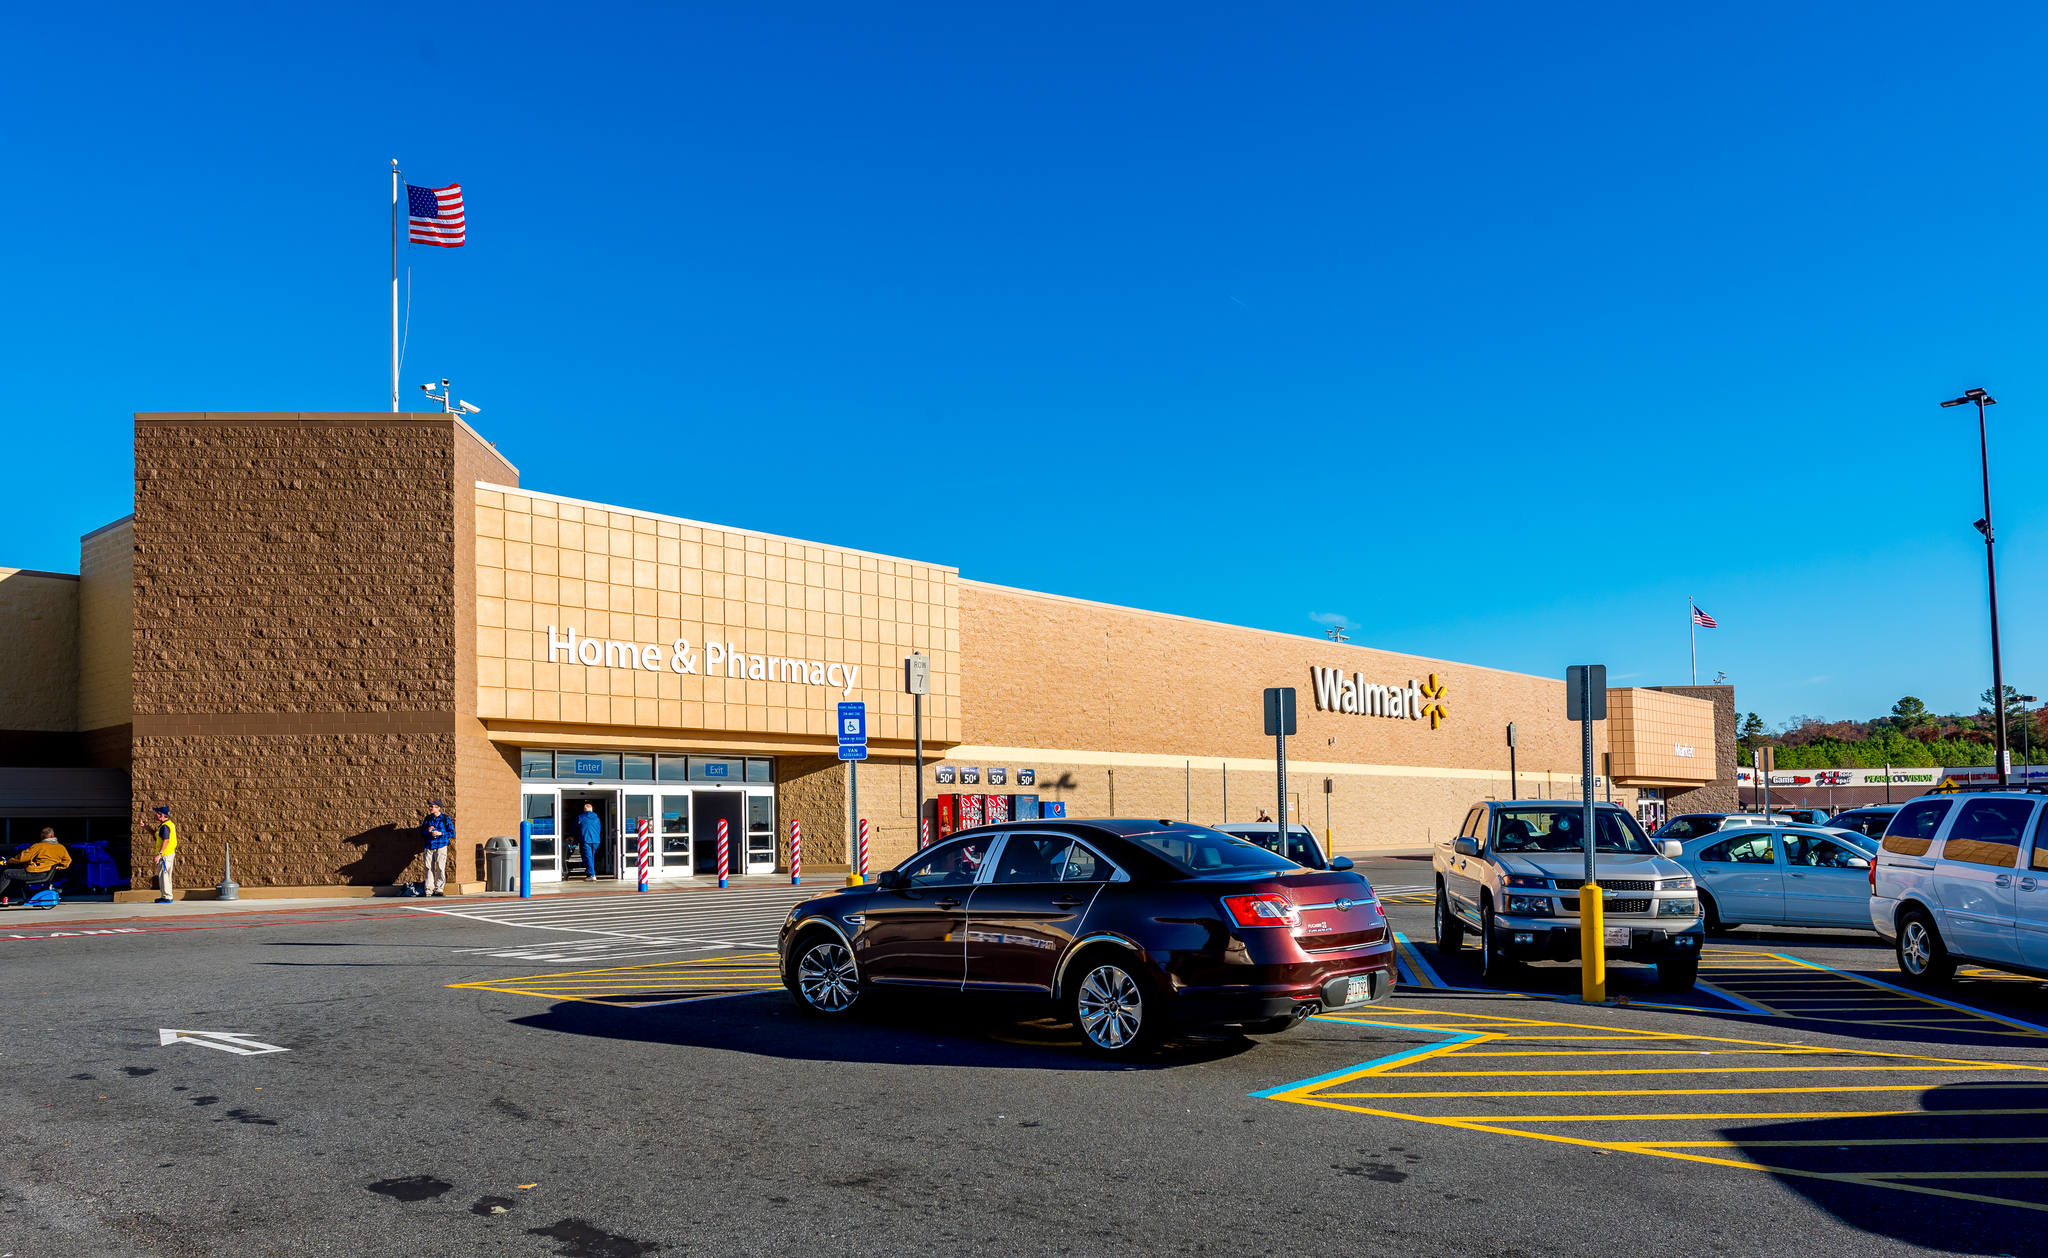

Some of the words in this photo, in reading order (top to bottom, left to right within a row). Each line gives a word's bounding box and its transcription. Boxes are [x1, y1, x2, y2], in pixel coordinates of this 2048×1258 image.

[548, 625, 662, 672] Home
[670, 638, 697, 675] &
[706, 641, 858, 696] Pharmacy
[913, 661, 927, 669] ROW
[916, 674, 924, 688] 7
[1310, 666, 1422, 720] Walmart
[1674, 742, 1695, 758] Market
[577, 761, 601, 773] Enter
[709, 765, 724, 775] Exit
[1772, 776, 1812, 784] GameStop
[1906, 774, 1933, 783] VISION
